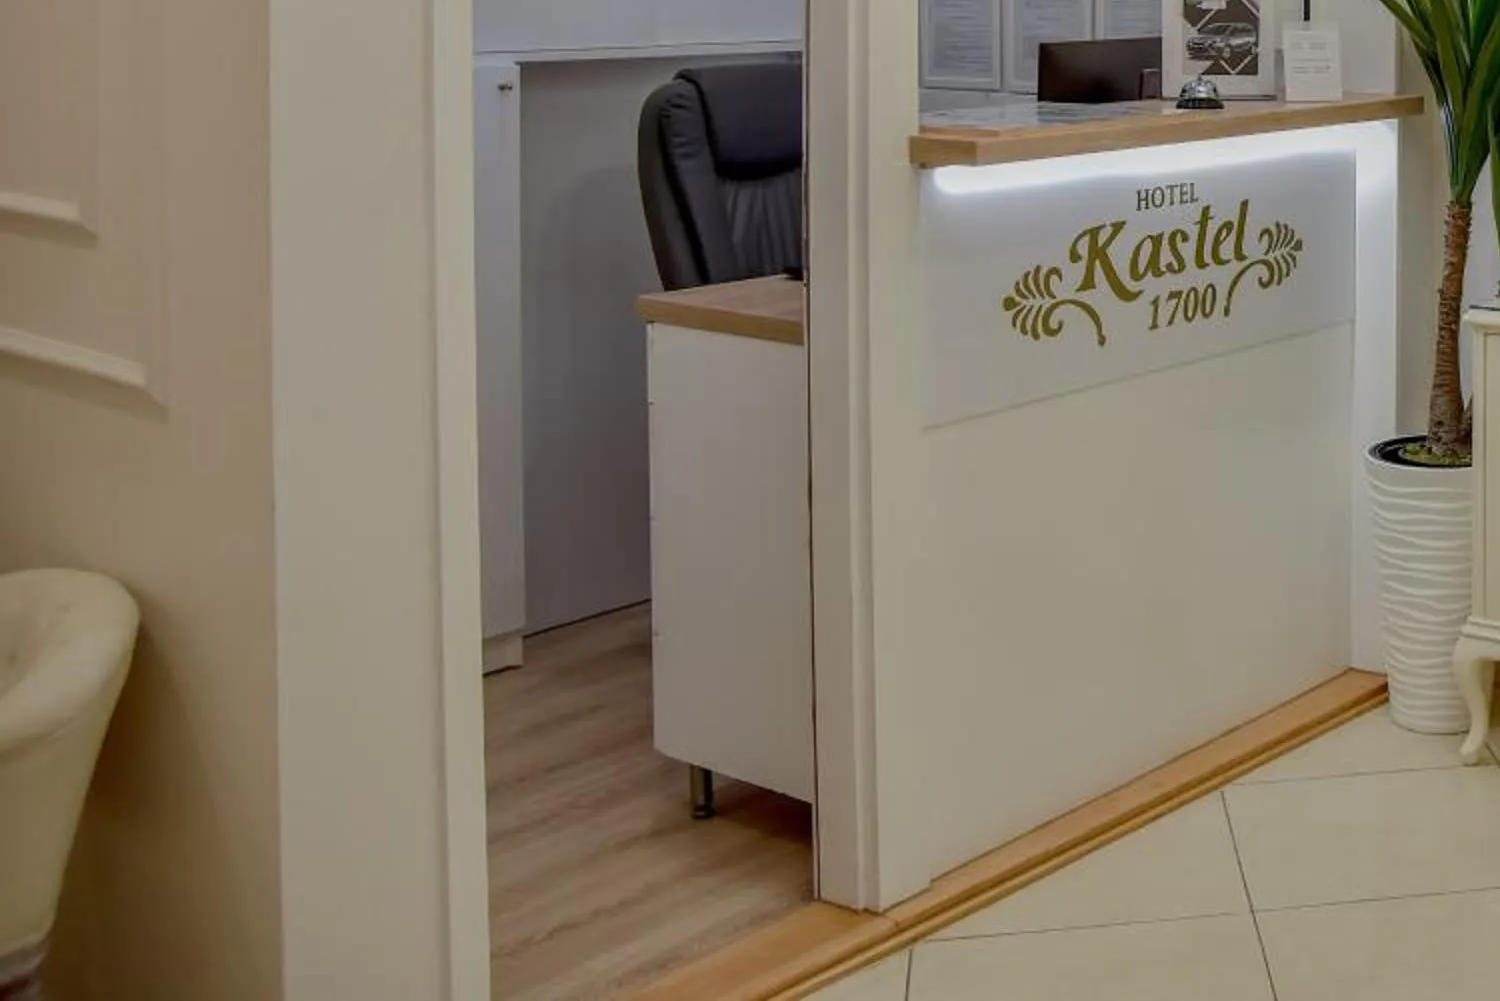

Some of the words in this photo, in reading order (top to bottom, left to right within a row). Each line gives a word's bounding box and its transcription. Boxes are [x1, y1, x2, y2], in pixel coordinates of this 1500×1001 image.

[1136, 183, 1199, 212] HOTEL
[1069, 199, 1249, 302] Kastel
[1149, 283, 1217, 330] 1700
